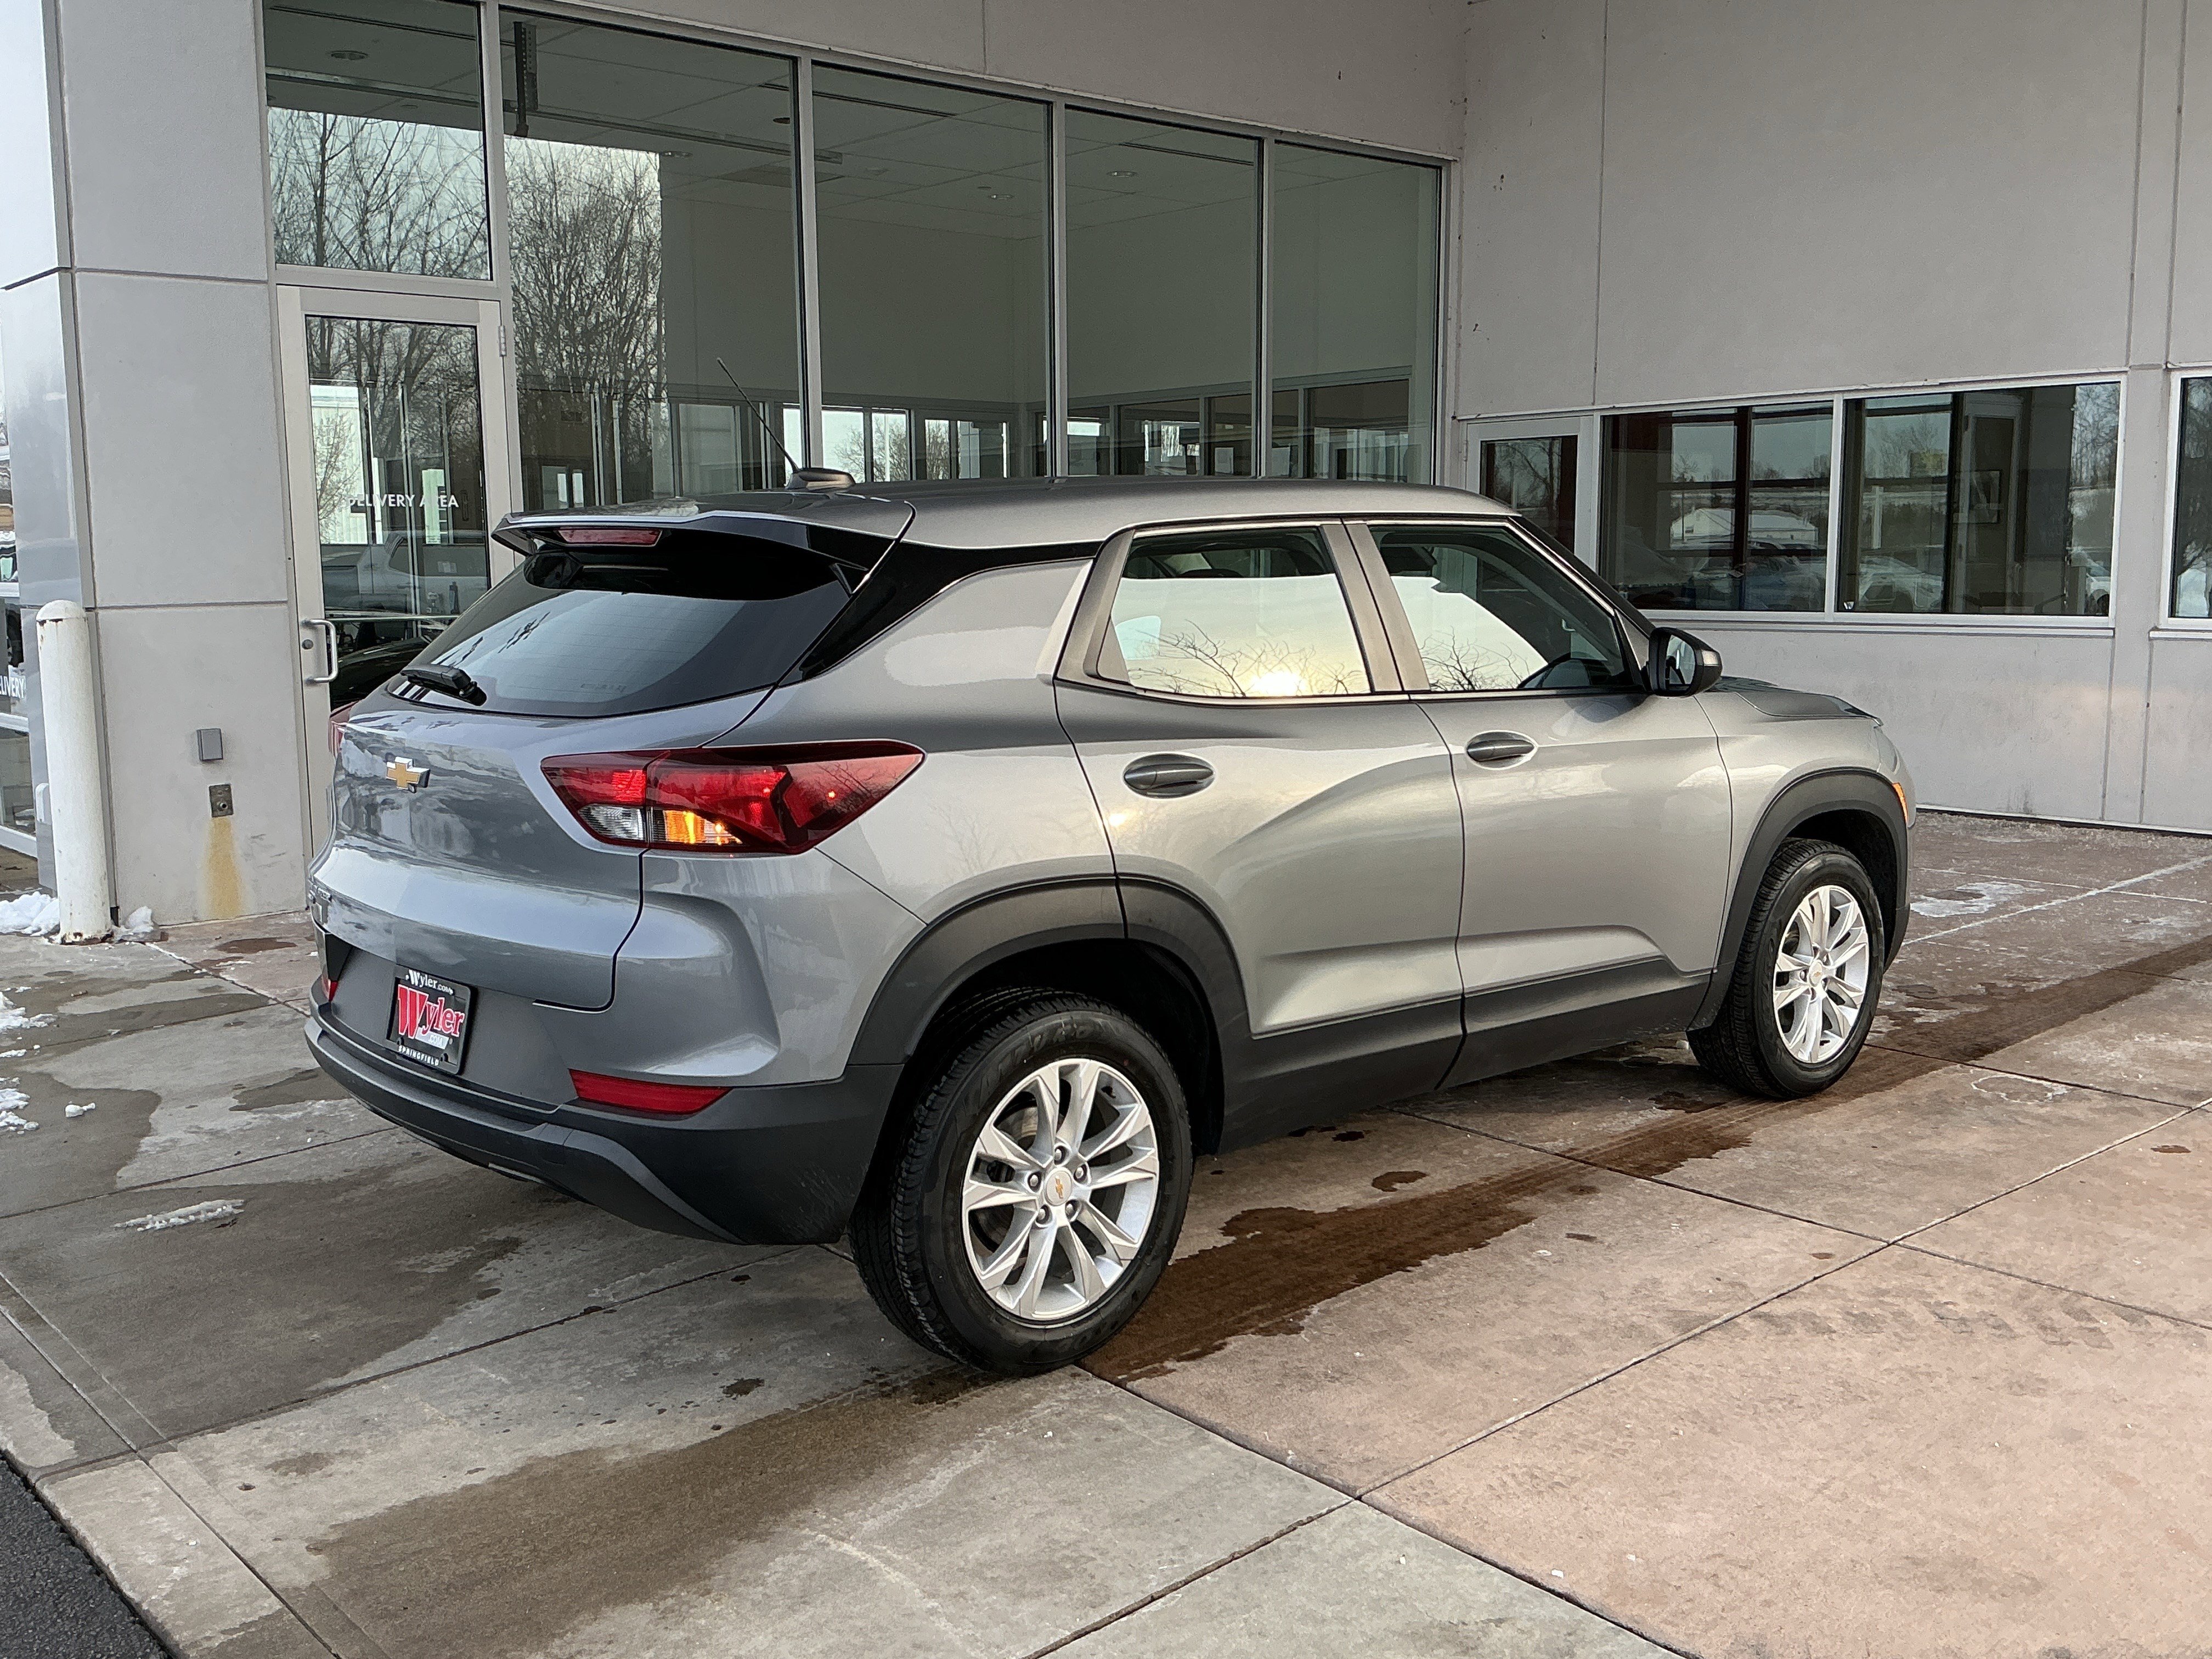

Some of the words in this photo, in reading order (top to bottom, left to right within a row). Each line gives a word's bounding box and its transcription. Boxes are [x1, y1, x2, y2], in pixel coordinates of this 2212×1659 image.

[0, 675, 24, 698] LIVERY
[398, 984, 465, 1039] Wyler
[398, 1045, 439, 1066] SPRINGFIELD
